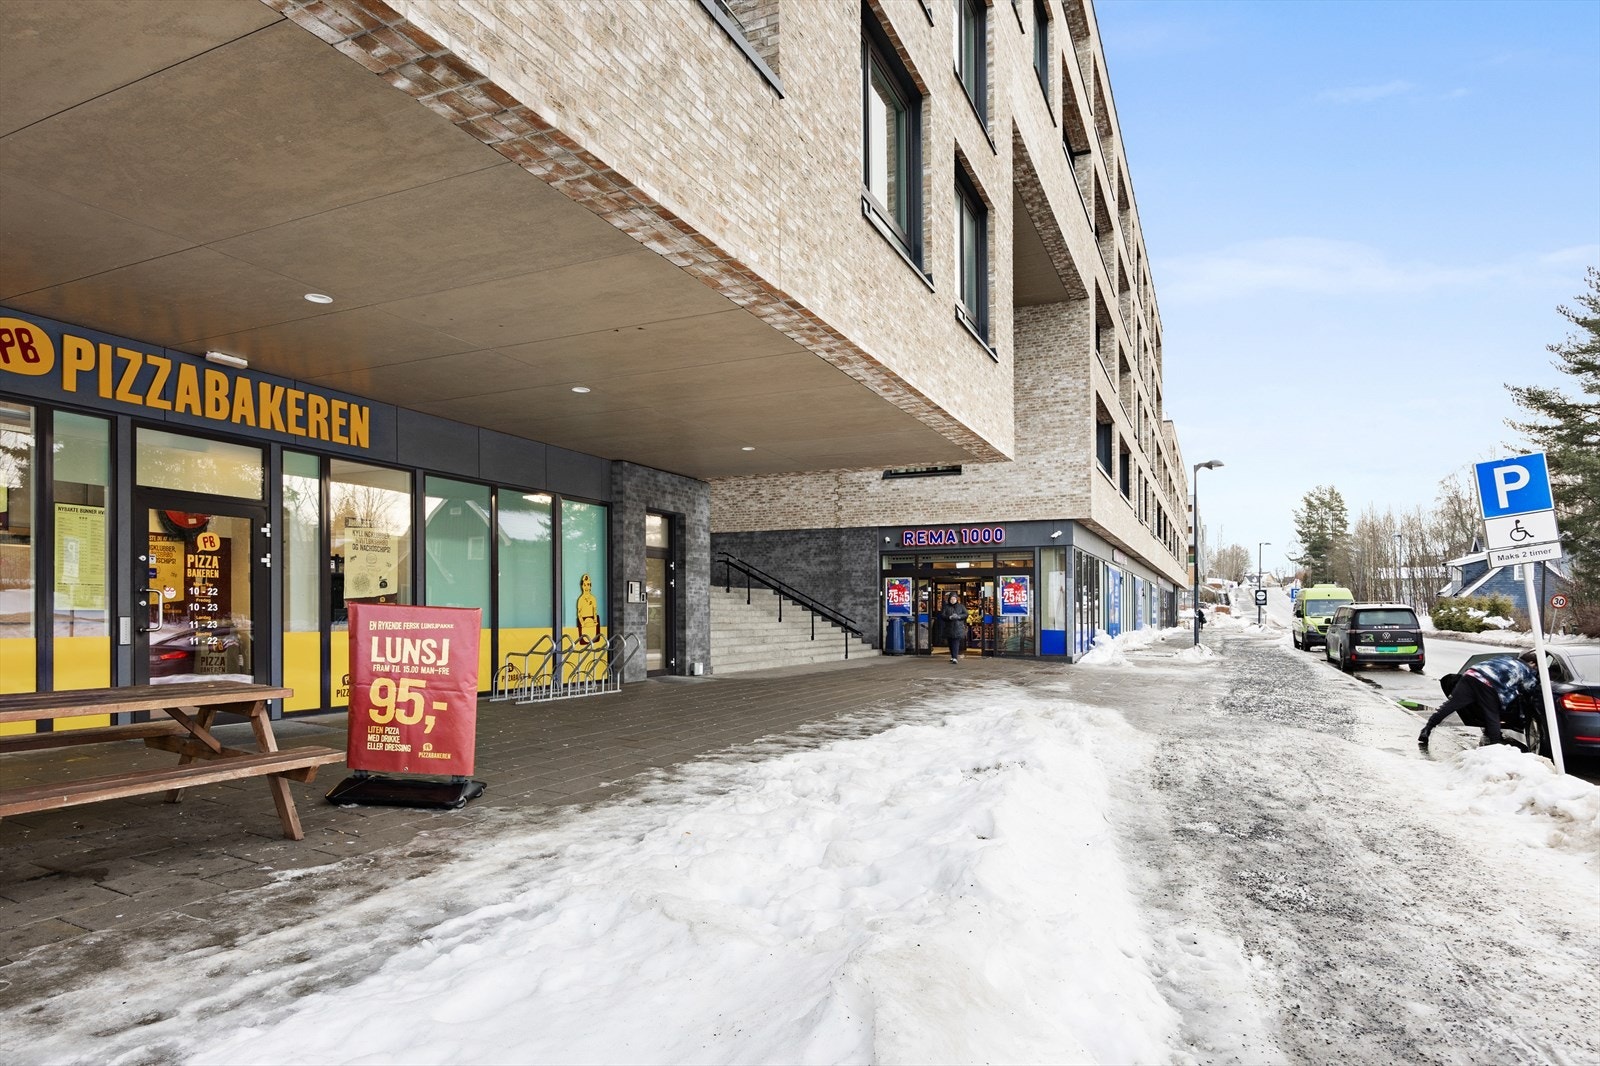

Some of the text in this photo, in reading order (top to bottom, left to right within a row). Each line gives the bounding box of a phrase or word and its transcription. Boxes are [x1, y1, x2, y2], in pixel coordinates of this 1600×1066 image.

[0, 328, 40, 364] PB
[62, 334, 370, 449] PIZZABAKEREN
[1493, 464, 1530, 509] P
[903, 527, 1005, 545] REMA 1000
[203, 535, 216, 549] PB
[1497, 552, 1520, 561] Maks
[1529, 548, 1552, 557] timer
[187, 554, 219, 569] PIZZA
[187, 569, 219, 578] BAKEREN
[189, 587, 200, 595] 10
[207, 587, 218, 596] 22
[189, 603, 200, 611] 10
[207, 603, 218, 611] 23
[1553, 597, 1565, 606] 30
[369, 620, 378, 630] EN
[378, 621, 402, 630] RYKENDE
[403, 622, 420, 630] FERSK
[189, 637, 199, 645] 11
[207, 637, 218, 645] 22
[370, 636, 450, 666] LUNSJ
[201, 656, 226, 667] PIZZA
[372, 664, 390, 673] FRAM
[391, 665, 401, 673] TIL
[403, 666, 419, 674] 15.00
[368, 677, 448, 734] 95,-
[368, 725, 400, 735] LITEN PIZZA
[367, 734, 400, 744] MED DRIKKE
[367, 742, 412, 753] ELLER DRESSING
[418, 752, 451, 760] PIZZABAKEREN
